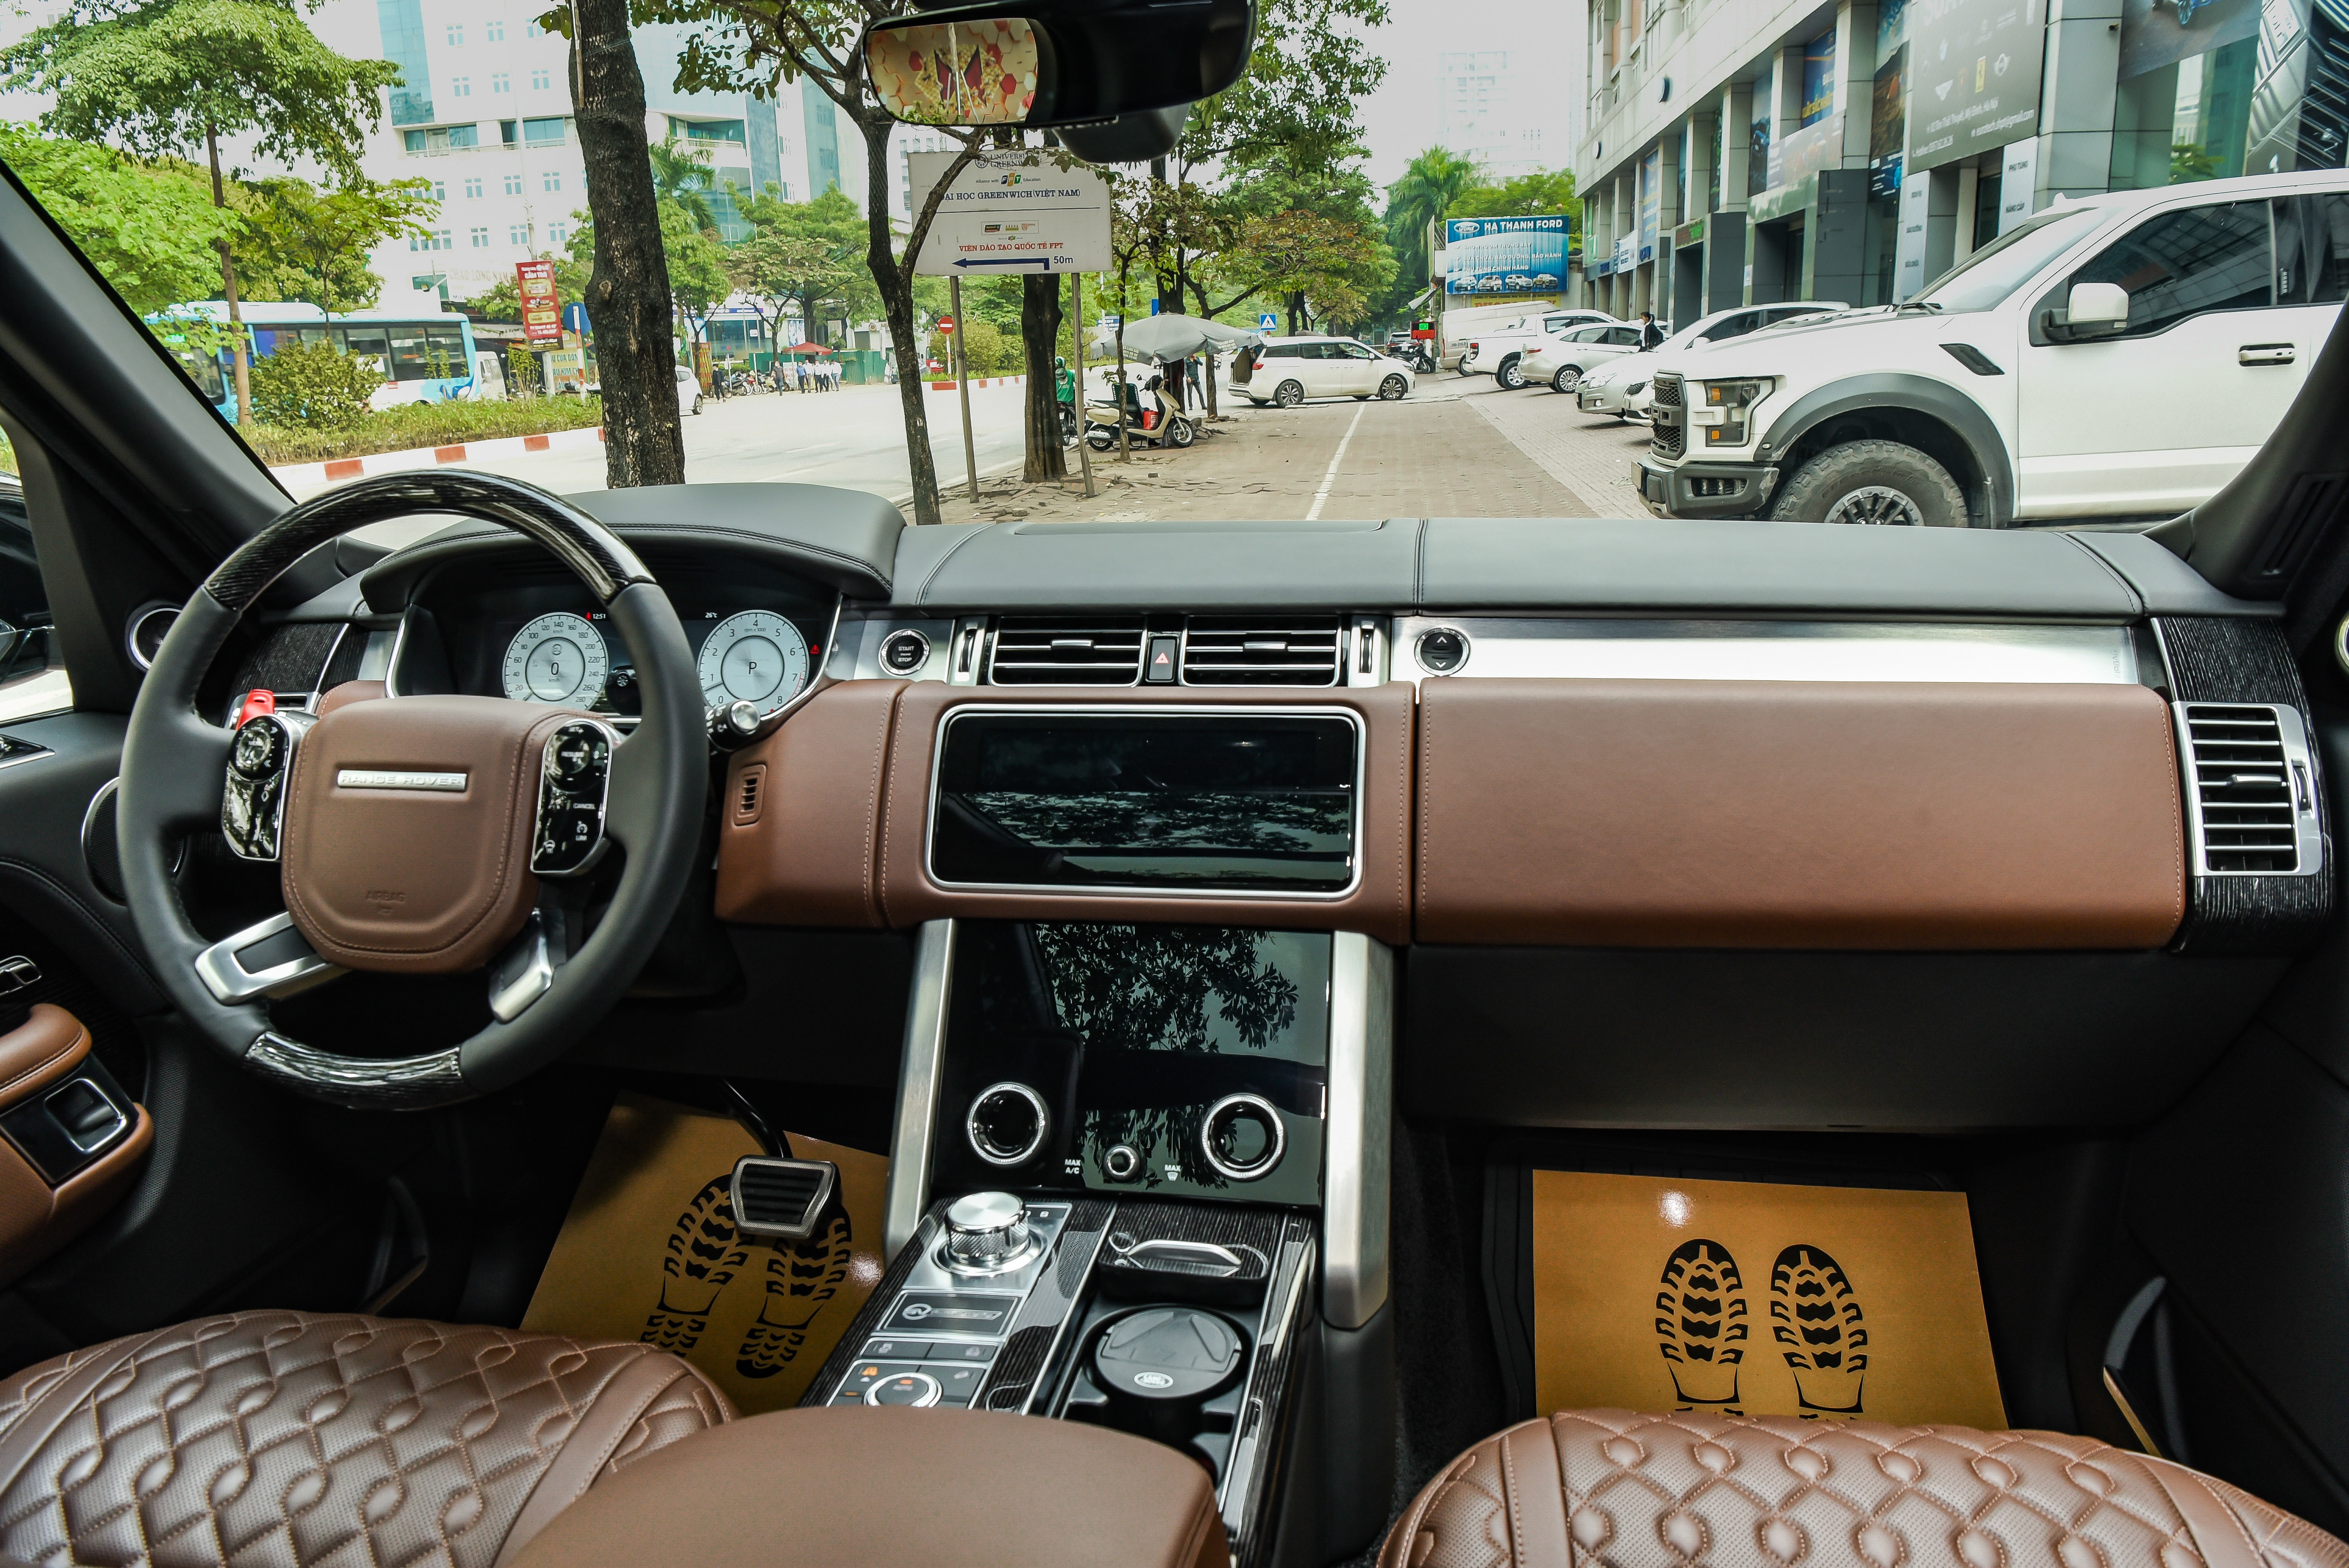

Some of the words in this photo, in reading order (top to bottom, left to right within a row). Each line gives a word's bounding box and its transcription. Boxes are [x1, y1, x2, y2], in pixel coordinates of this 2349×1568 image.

[1001, 173, 1021, 186] FPT
[956, 192, 975, 202] HỌC
[1500, 221, 1534, 230] THANH
[1536, 219, 1563, 229] FORD
[1014, 242, 1035, 250] QUỐC
[1037, 241, 1047, 249] TẾ
[1053, 256, 1074, 264] 50m
[1413, 330, 1435, 339] PHOTO
[729, 629, 735, 637] 3
[775, 628, 781, 637] 5
[712, 648, 718, 656] 2
[790, 647, 795, 656] 6
[551, 662, 559, 675] 0
[749, 661, 757, 675] P
[2111, 650, 2121, 679] AIRBAG
[710, 673, 714, 681] 1
[792, 673, 798, 682] 7
[718, 695, 724, 704] 0
[777, 695, 783, 704] 8
[341, 775, 396, 784] RANGE
[403, 777, 462, 786] ROVER
[365, 890, 406, 902] AIRBAG
